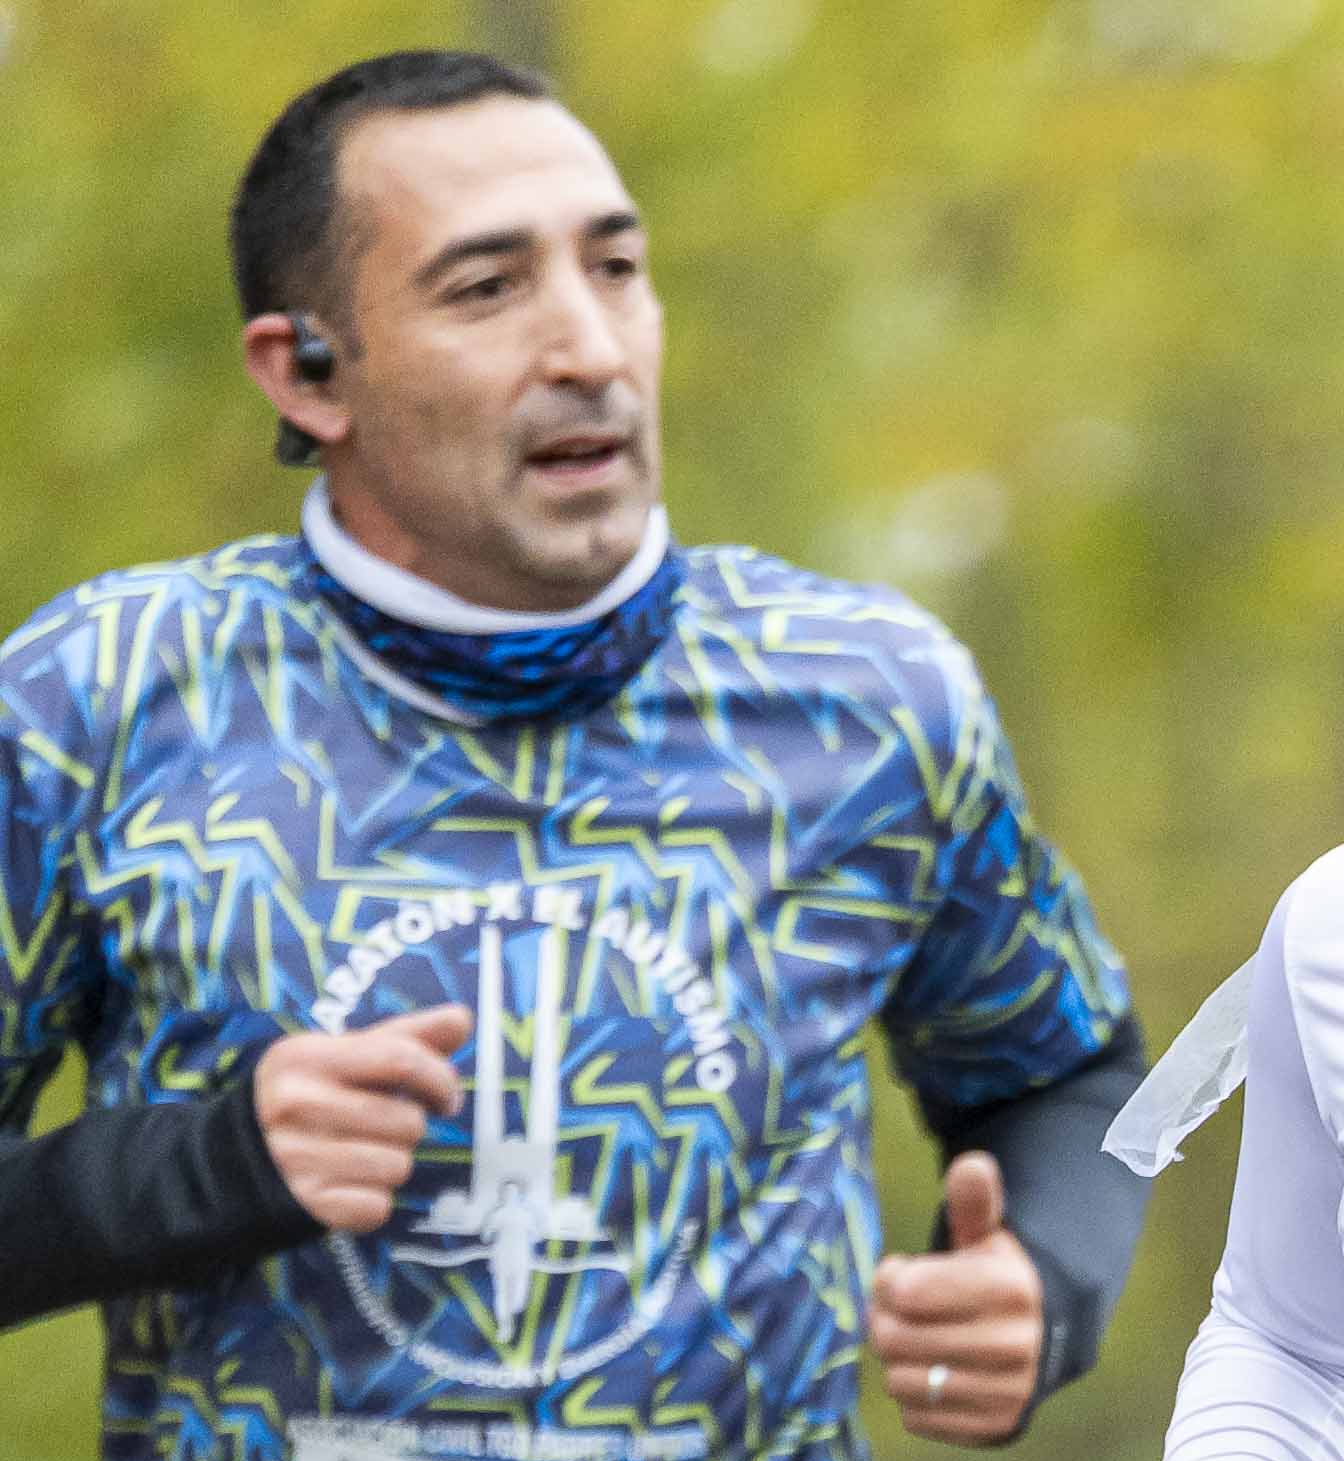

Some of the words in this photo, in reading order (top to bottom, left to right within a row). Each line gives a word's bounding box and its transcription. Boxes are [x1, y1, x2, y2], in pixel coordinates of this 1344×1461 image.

[484, 881, 521, 922] X
[532, 884, 584, 931] EL
[588, 907, 738, 1093] AUTISMO
